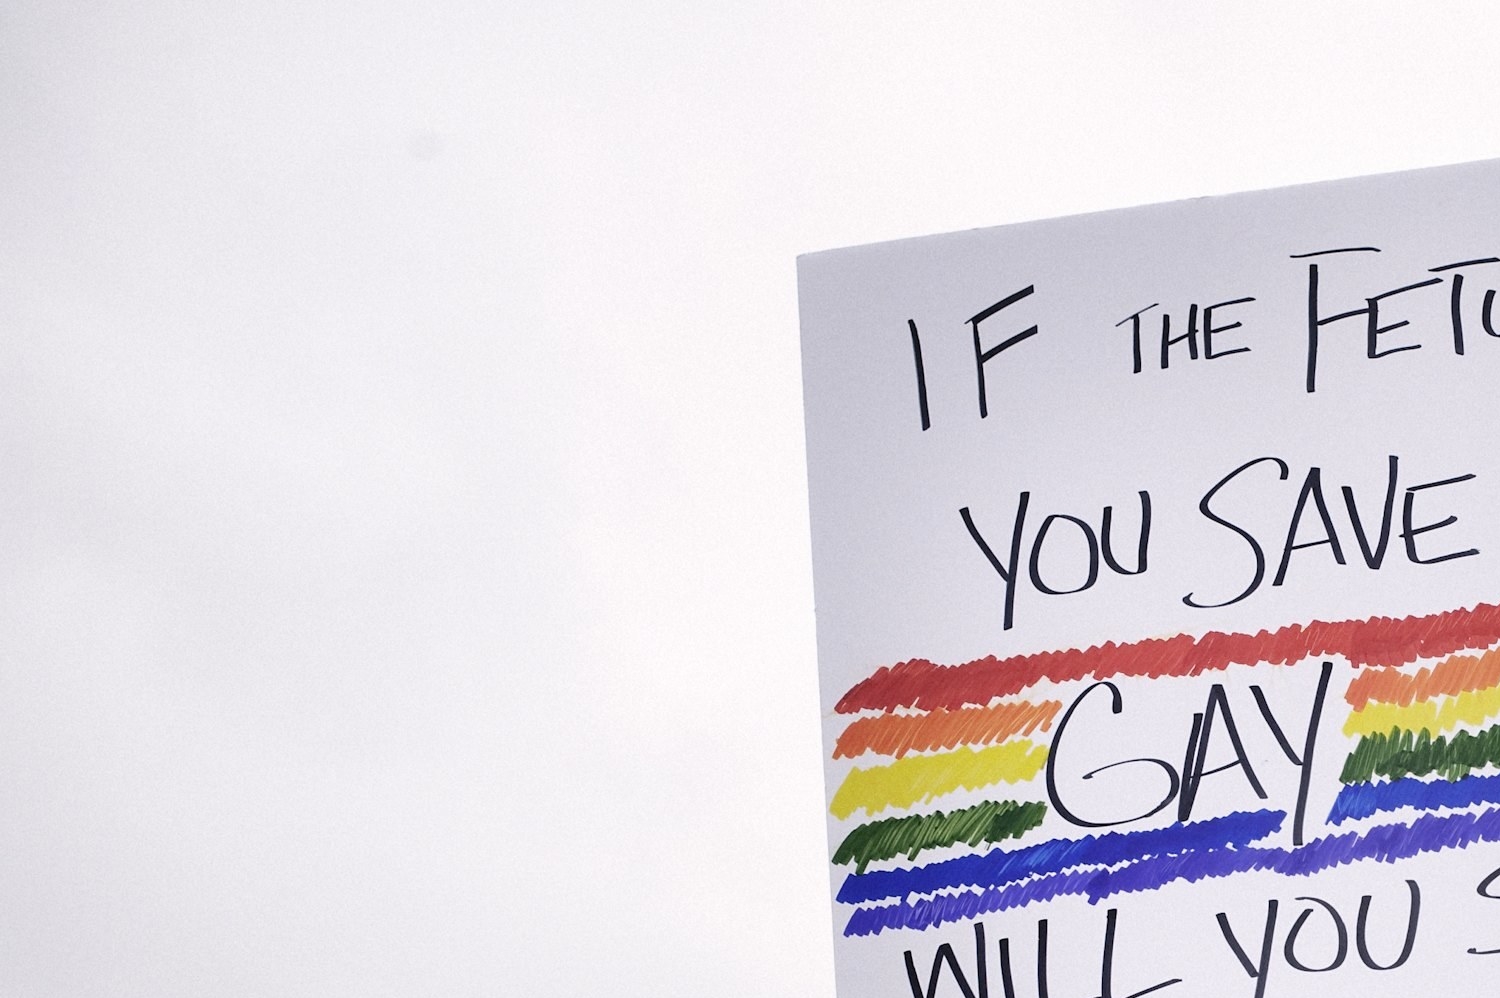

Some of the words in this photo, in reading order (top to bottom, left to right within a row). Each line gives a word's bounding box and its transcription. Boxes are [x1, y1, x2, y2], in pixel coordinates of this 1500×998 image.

[906, 284, 1038, 432] IF
[1115, 296, 1256, 374] THE
[958, 490, 1152, 631] YOU
[1182, 456, 1480, 607] SAVE
[1046, 661, 1334, 846] GAY
